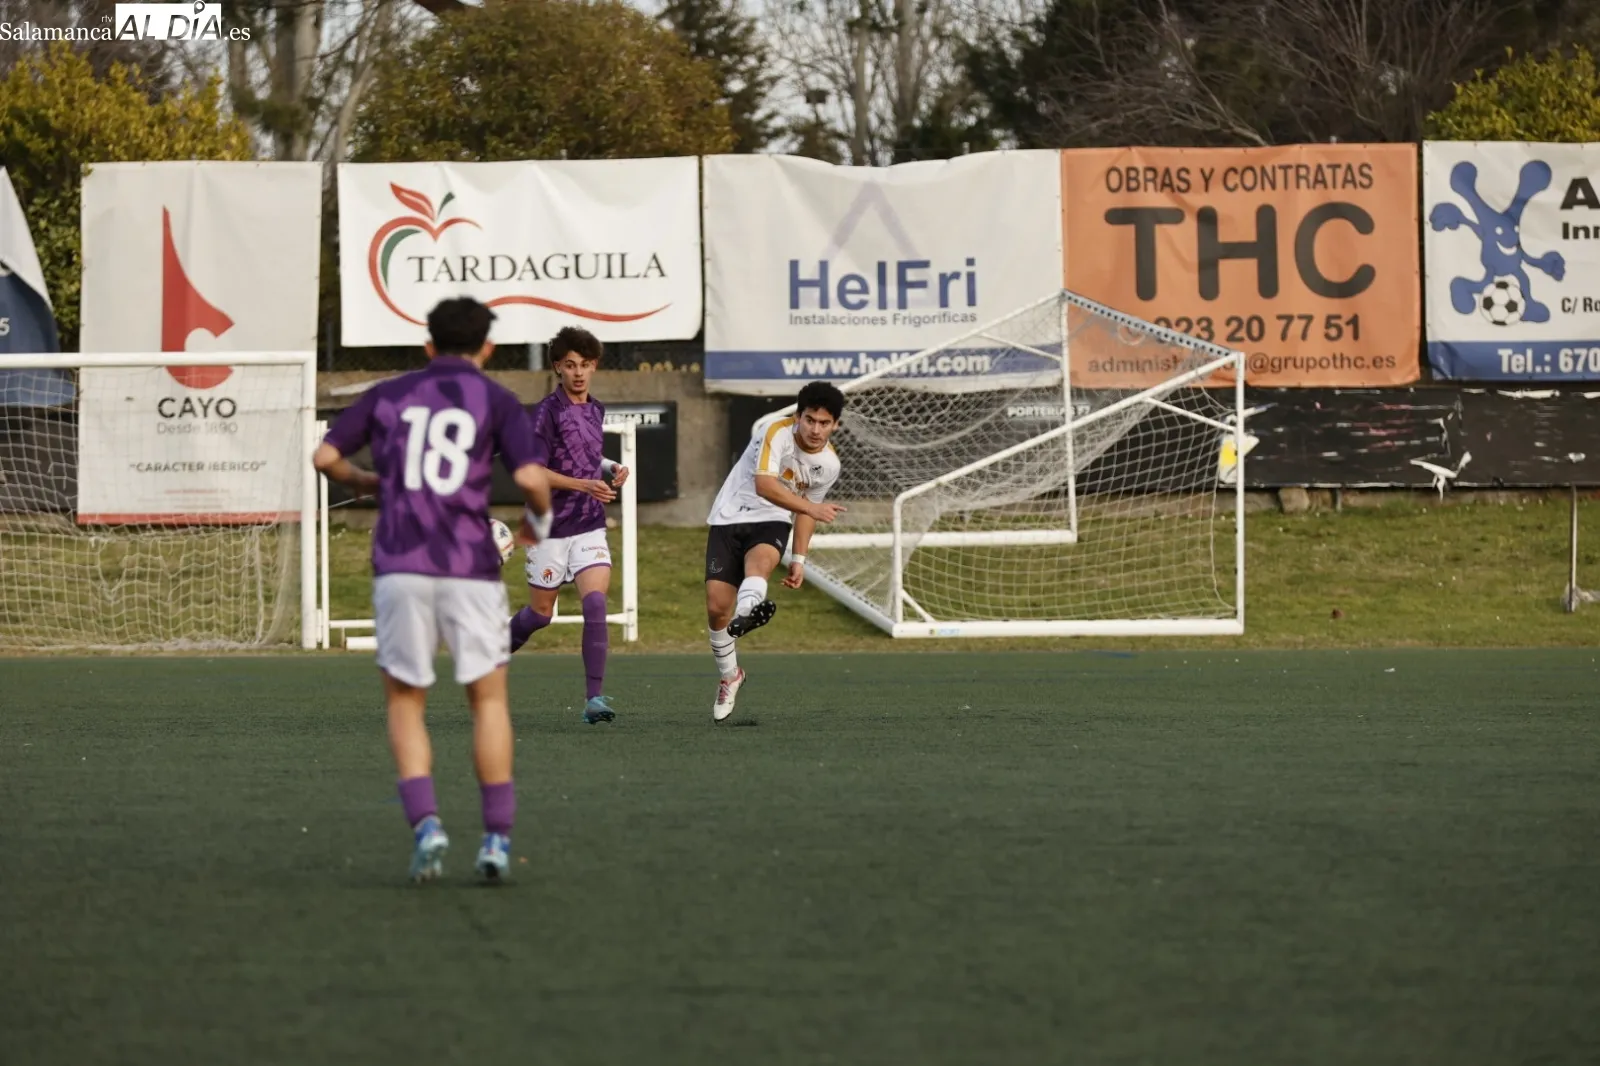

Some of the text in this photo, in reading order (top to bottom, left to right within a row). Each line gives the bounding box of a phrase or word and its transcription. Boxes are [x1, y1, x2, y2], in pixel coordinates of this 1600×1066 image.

[1105, 161, 1374, 193] OBRAS Y CONTRATAS
[1103, 201, 1377, 302] THC
[407, 252, 668, 283] TARDAGUILA
[788, 256, 978, 311] HelFri
[788, 312, 888, 327] Instalaciones
[1225, 315, 1265, 342] 20
[1276, 314, 1314, 341] 77
[1324, 313, 1361, 341] 51
[1498, 348, 1551, 374] Tel.:
[157, 396, 238, 420] CAYO
[401, 405, 477, 497] 18
